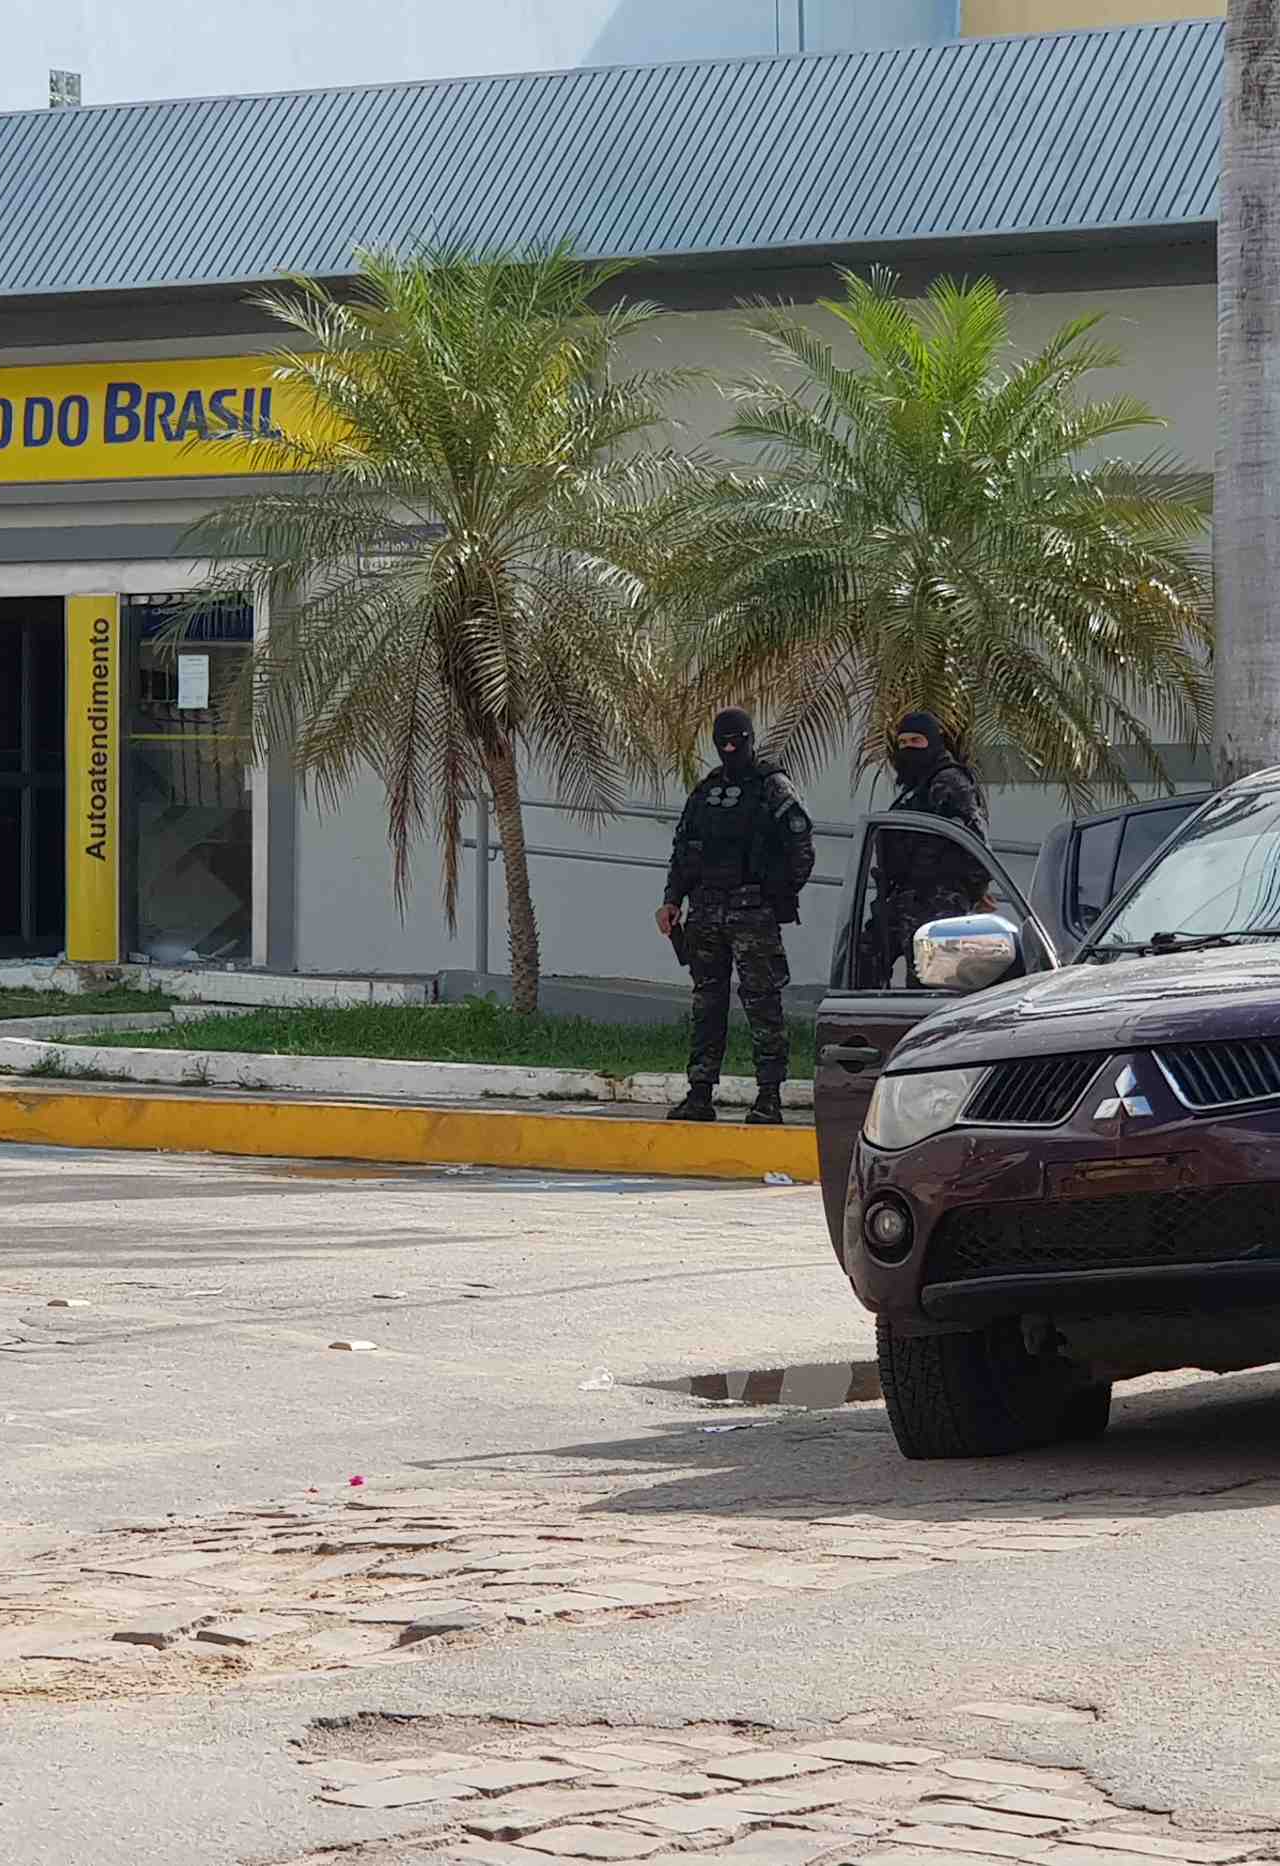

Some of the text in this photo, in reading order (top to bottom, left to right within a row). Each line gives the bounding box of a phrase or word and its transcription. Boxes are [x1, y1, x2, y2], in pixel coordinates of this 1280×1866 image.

[23, 394, 89, 448] DO
[104, 382, 281, 444] BRASIL
[86, 617, 110, 862] Autoatendimento
